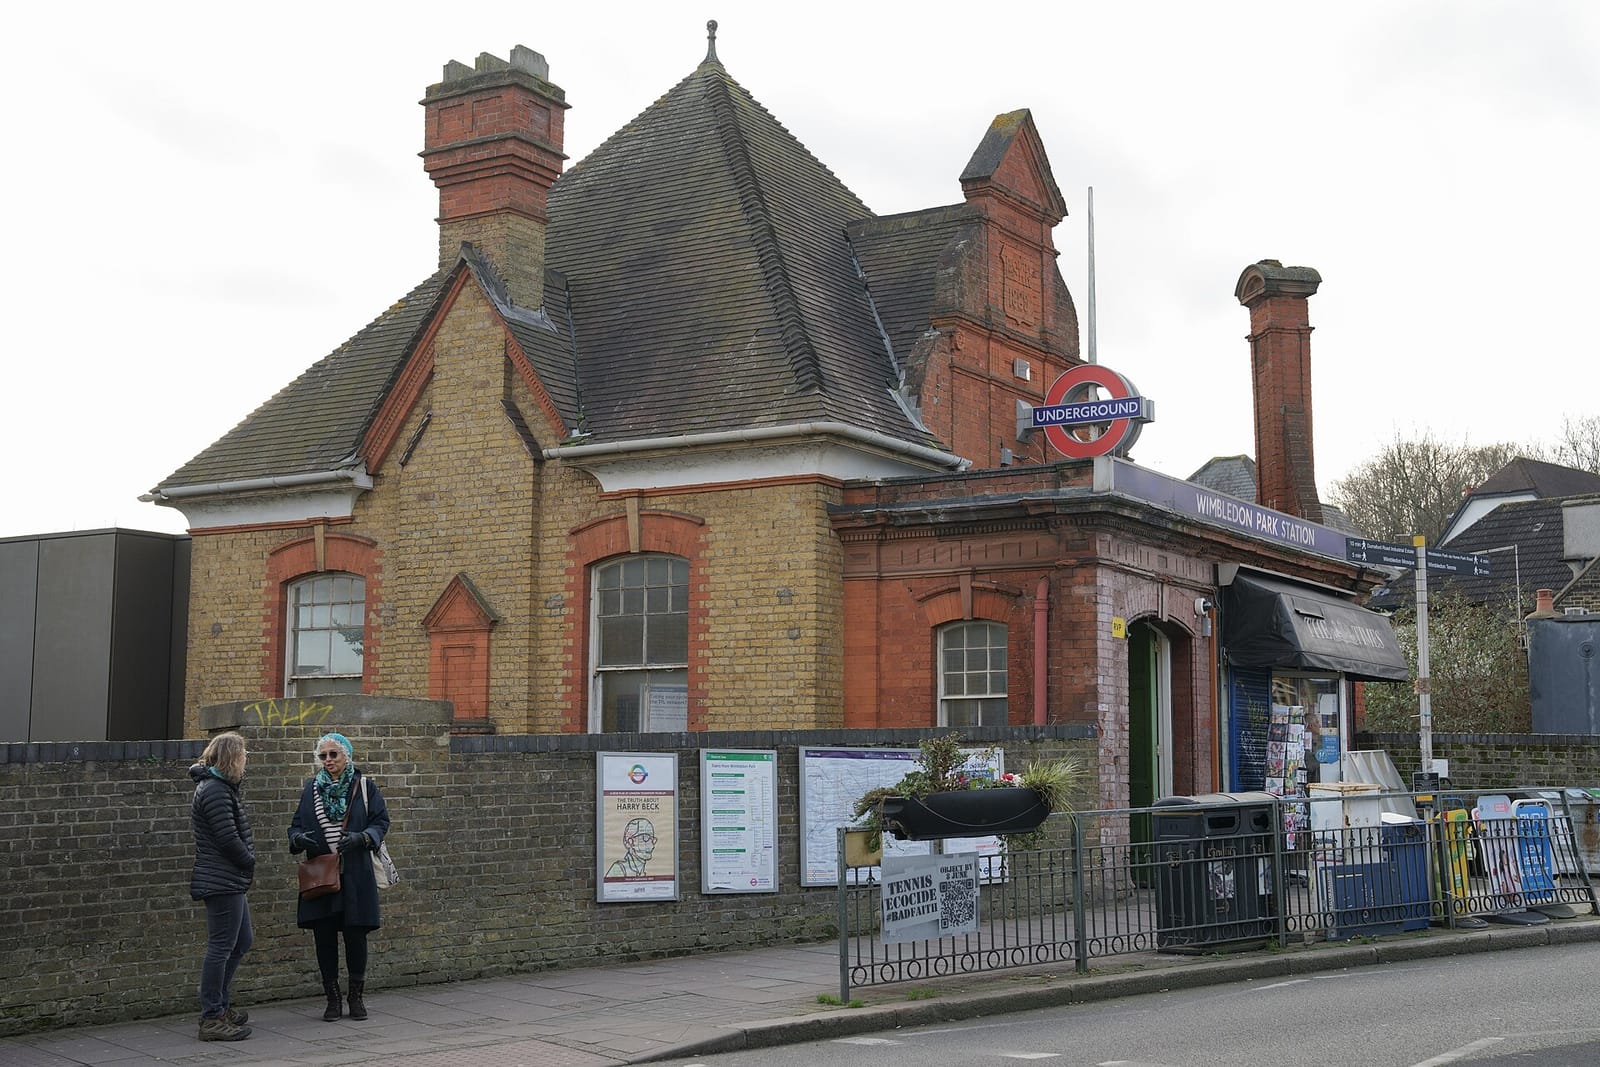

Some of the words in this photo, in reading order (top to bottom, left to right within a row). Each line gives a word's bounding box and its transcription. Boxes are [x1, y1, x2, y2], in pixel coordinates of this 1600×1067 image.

[1036, 401, 1139, 422] UNDERGROUND
[1196, 493, 1253, 529] WIMBLEDON
[1256, 511, 1278, 537] PARK
[1281, 520, 1315, 546] STATION
[1383, 556, 1401, 564] Wimbledon
[1427, 561, 1446, 569] Wimbledon
[1303, 616, 1332, 640] THE
[1351, 625, 1385, 649] TIMES
[616, 803, 640, 811] HARRY
[641, 803, 660, 811] BECK
[940, 864, 963, 874] OBJECT
[964, 863, 973, 871] BY
[952, 870, 968, 880] JUNE
[887, 874, 933, 895] TENNIS
[885, 888, 937, 911] ECOCIDE
[886, 902, 938, 922] #BADFAITH
